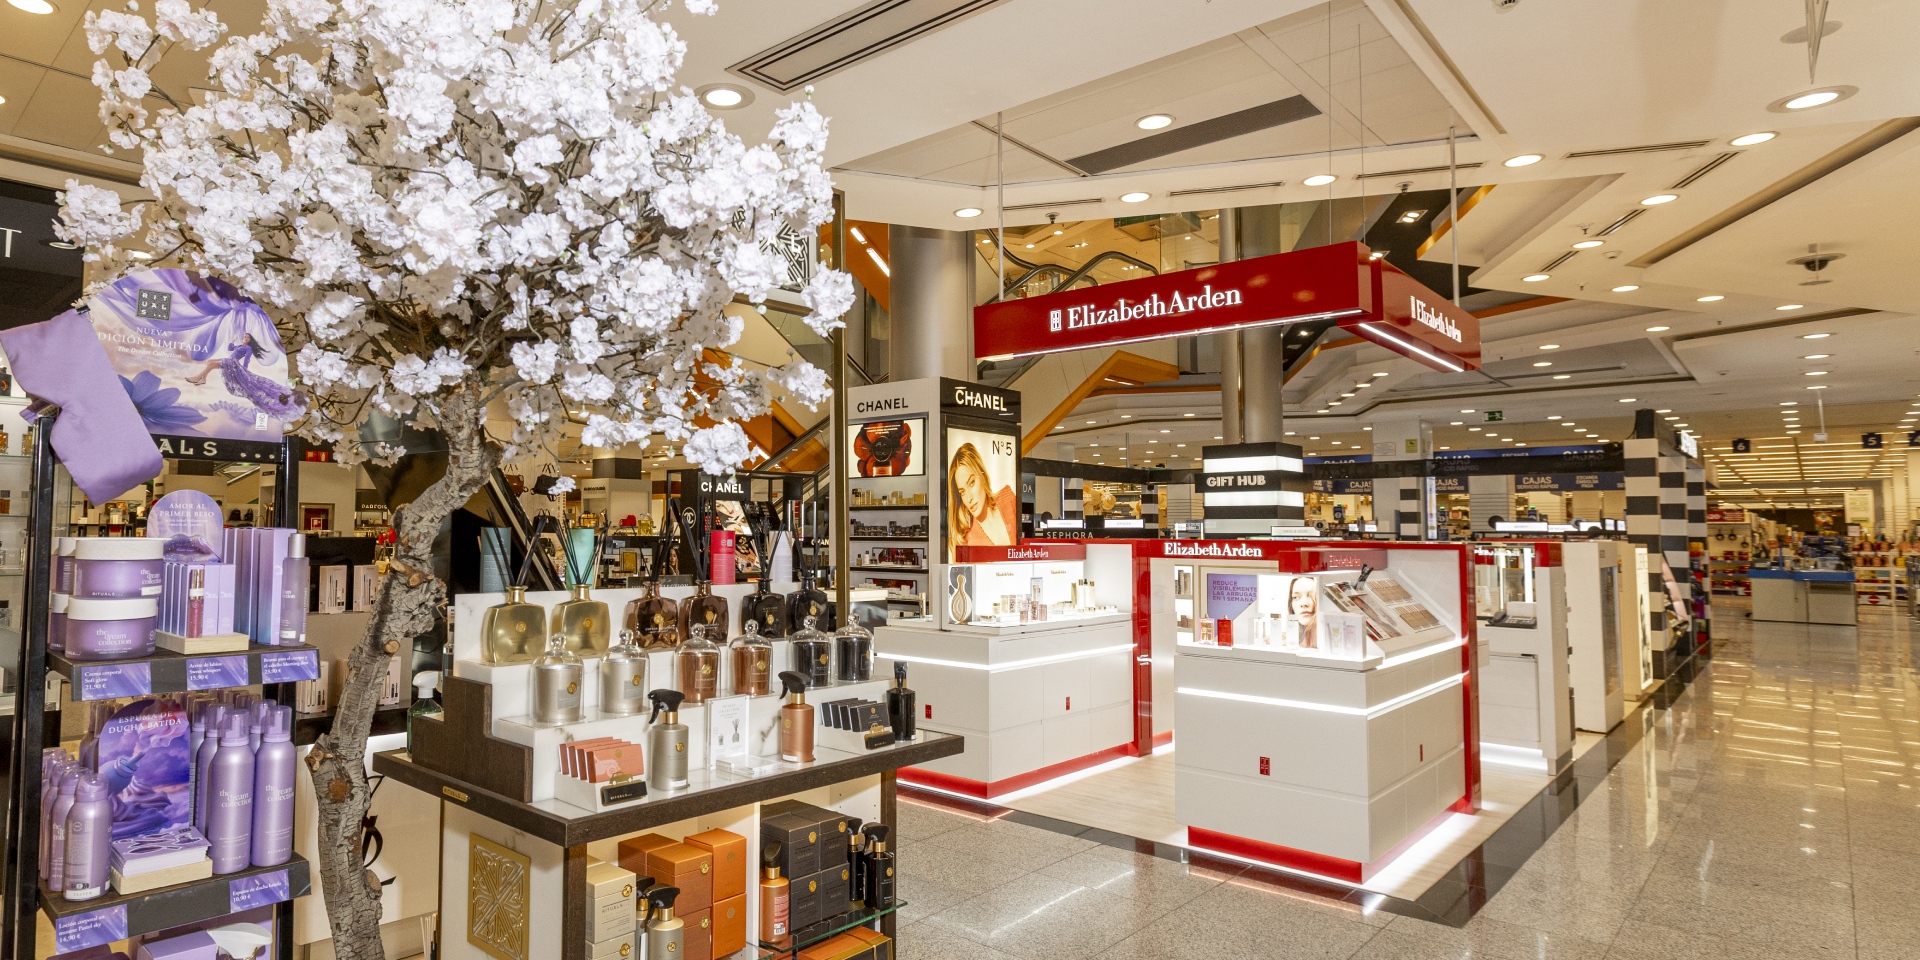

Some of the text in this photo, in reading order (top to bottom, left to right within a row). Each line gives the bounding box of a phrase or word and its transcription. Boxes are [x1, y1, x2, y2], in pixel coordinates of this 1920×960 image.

[136, 326, 168, 337] NUEVA
[98, 332, 209, 354] DICIÓN LIMITADA
[857, 397, 909, 413] CHANEL
[955, 389, 1008, 412] CHANEL
[1867, 436, 1878, 446] 5
[1737, 442, 1746, 451] 6
[1206, 474, 1266, 488] GIFT HUB
[1523, 476, 1552, 485] CAJAS
[169, 502, 194, 510] AMOR
[160, 510, 192, 518] PRIMER
[1046, 531, 1094, 539] SEPHORA
[1212, 585, 1258, 593] VISIBLEMENTE
[118, 713, 158, 724] ESPUMA
[108, 718, 182, 734] DUCHA BATIDA
